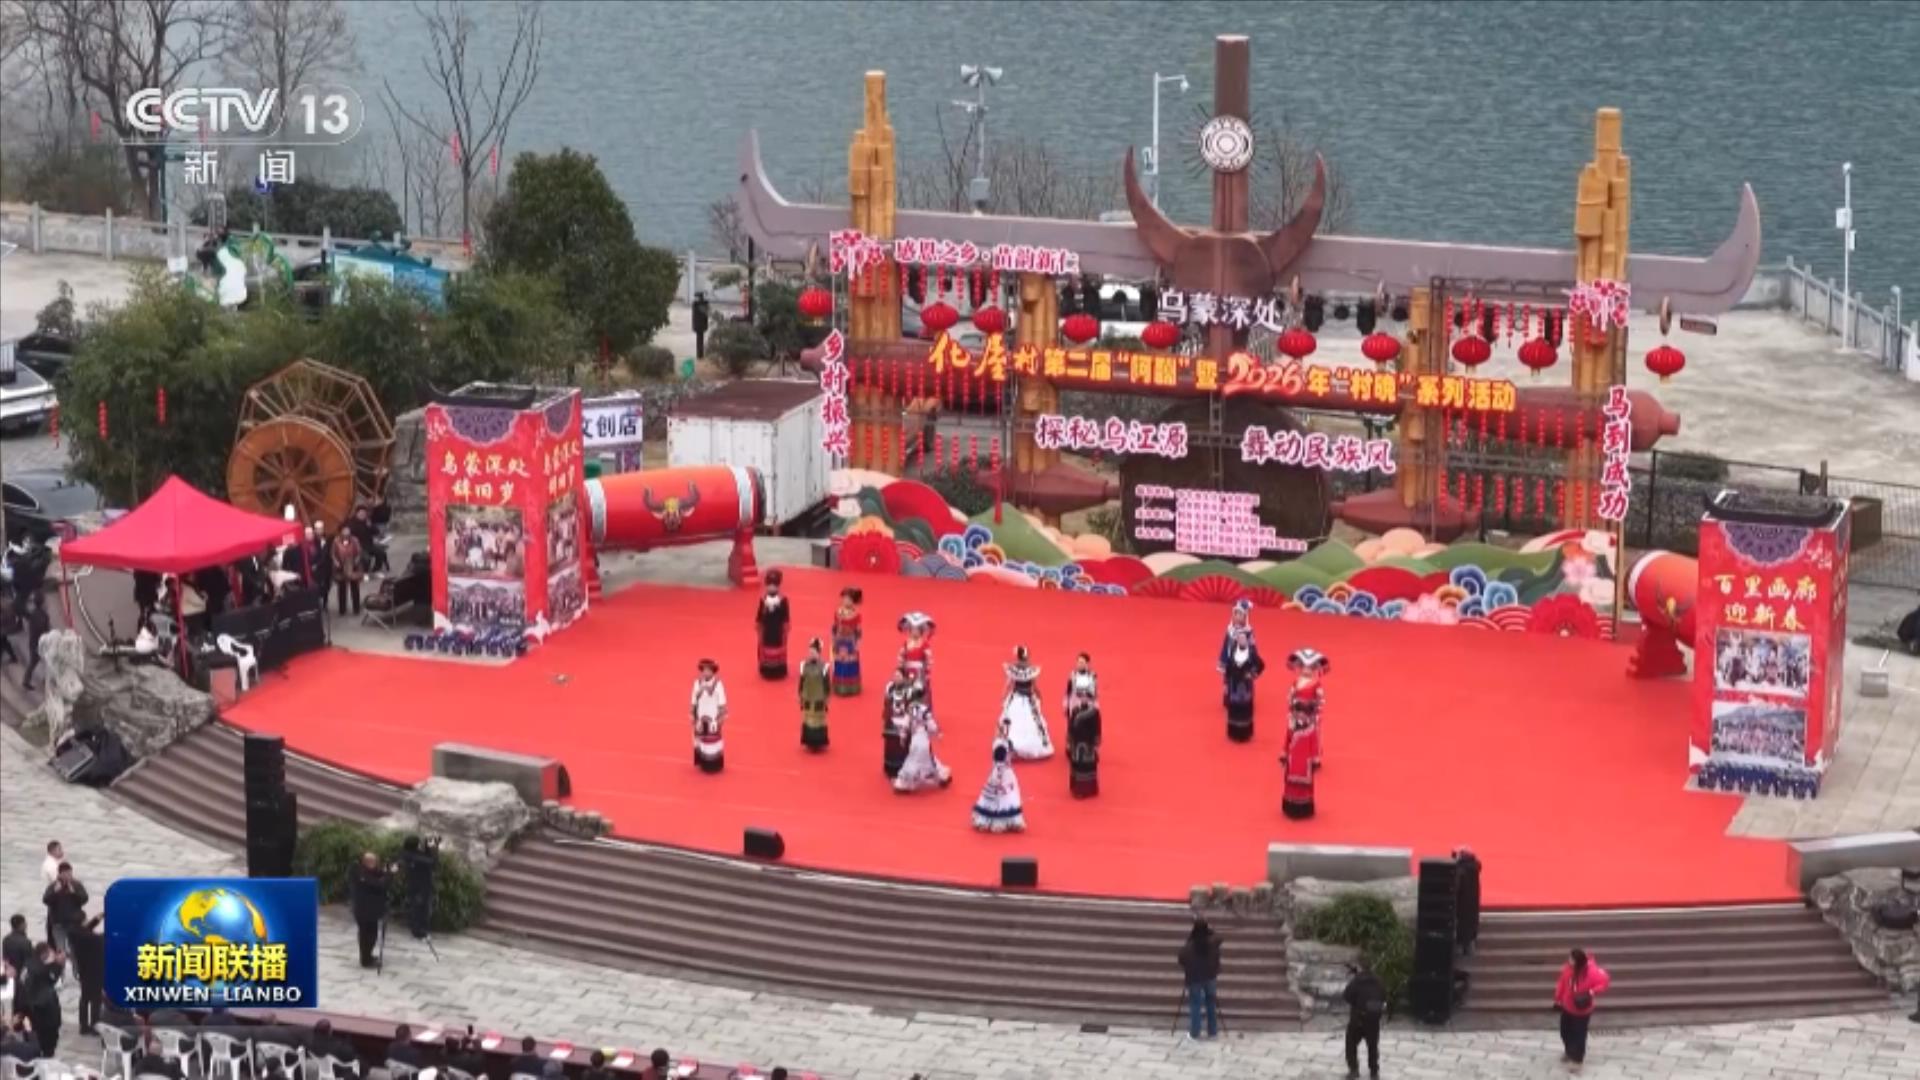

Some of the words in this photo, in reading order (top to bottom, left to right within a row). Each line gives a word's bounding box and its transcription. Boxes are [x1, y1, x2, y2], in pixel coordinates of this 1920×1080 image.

[1157, 287, 1284, 332] 乌蒙深处
[821, 328, 850, 457] 乡村振兴
[1034, 415, 1189, 459] 探秘乌江源
[1241, 426, 1397, 473] 舞动民族风
[1599, 384, 1632, 520] 马到成功
[441, 450, 531, 478] 乌蒙深处
[452, 481, 515, 505] 辞旧岁
[1713, 574, 1817, 603] 百里画廊
[1724, 602, 1806, 632] 迎新春
